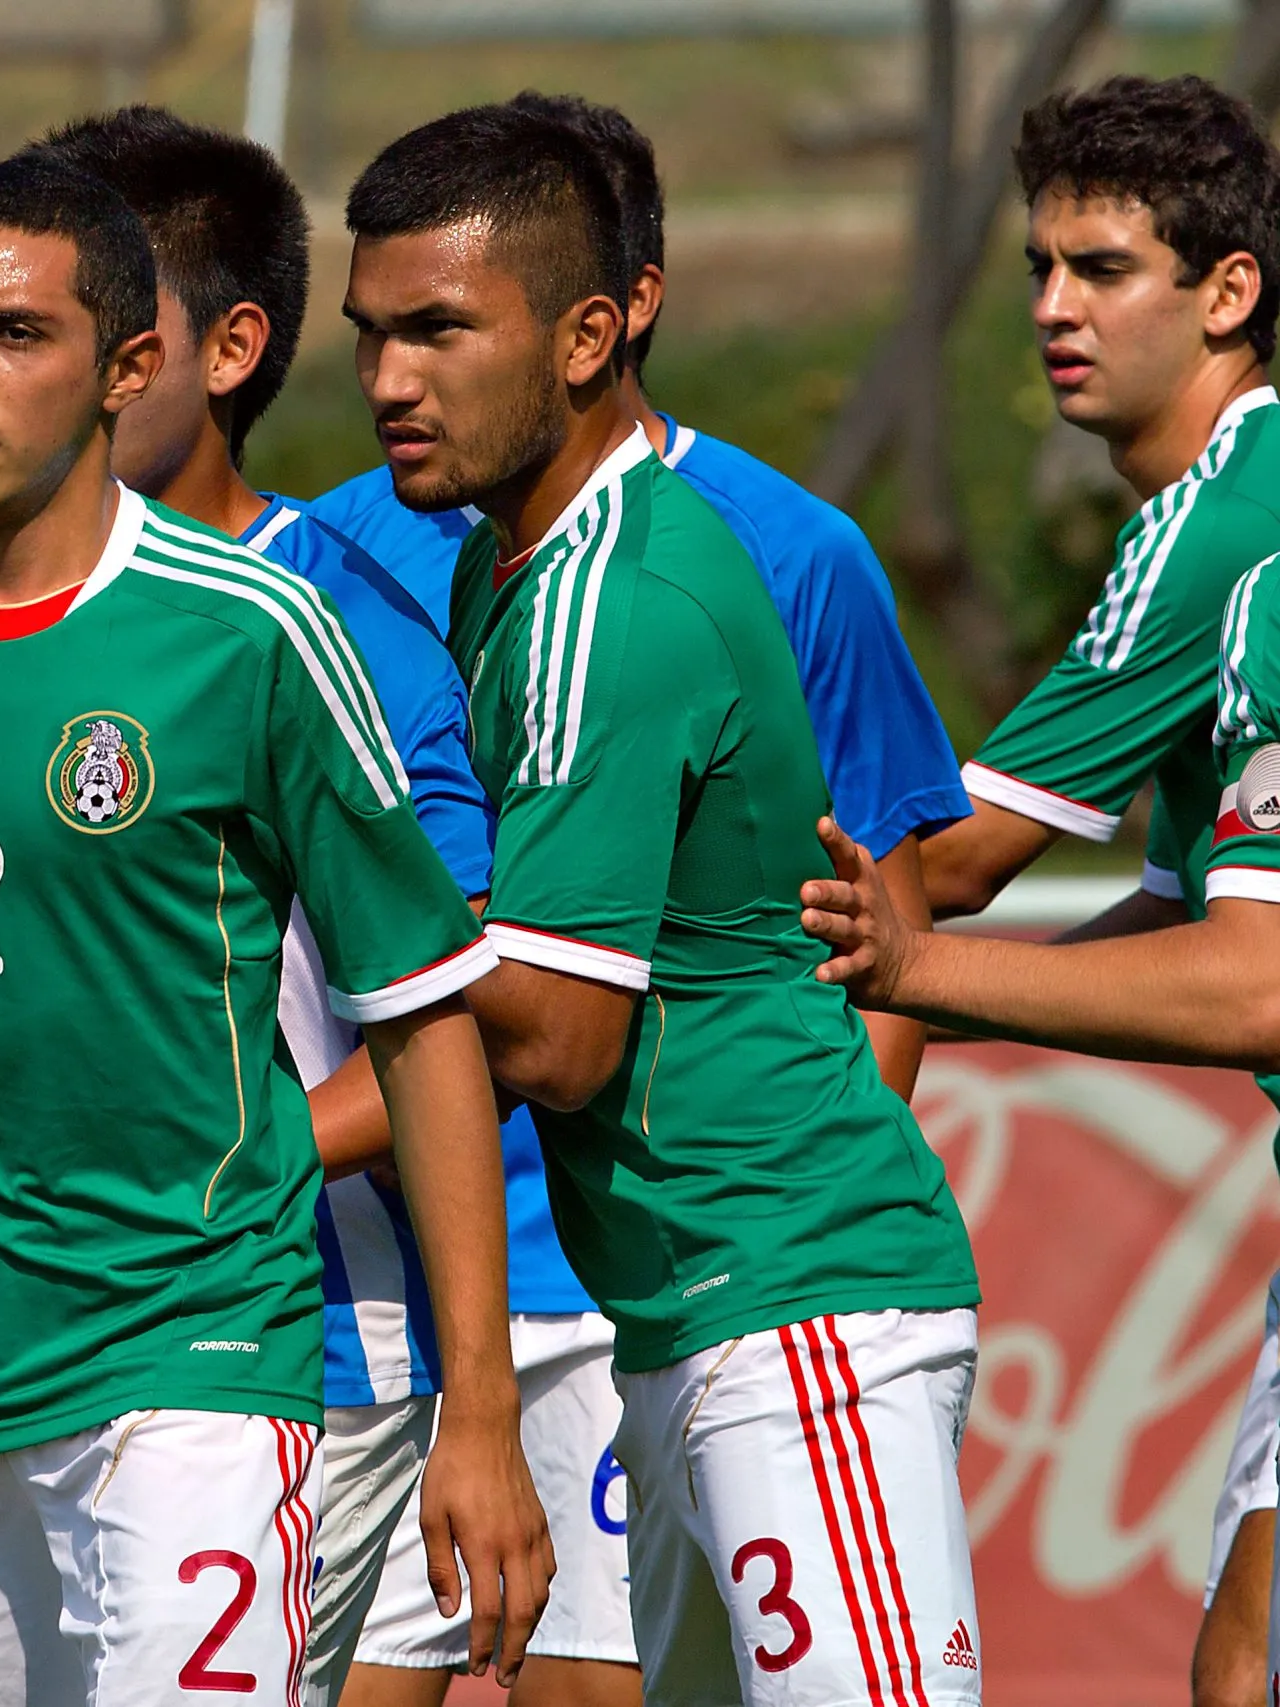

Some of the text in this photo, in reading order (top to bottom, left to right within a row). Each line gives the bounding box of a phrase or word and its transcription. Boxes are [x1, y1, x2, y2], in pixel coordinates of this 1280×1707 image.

[177, 1549, 258, 1693] 2
[731, 1537, 813, 1673] 3
[943, 1649, 977, 1671] adidas
